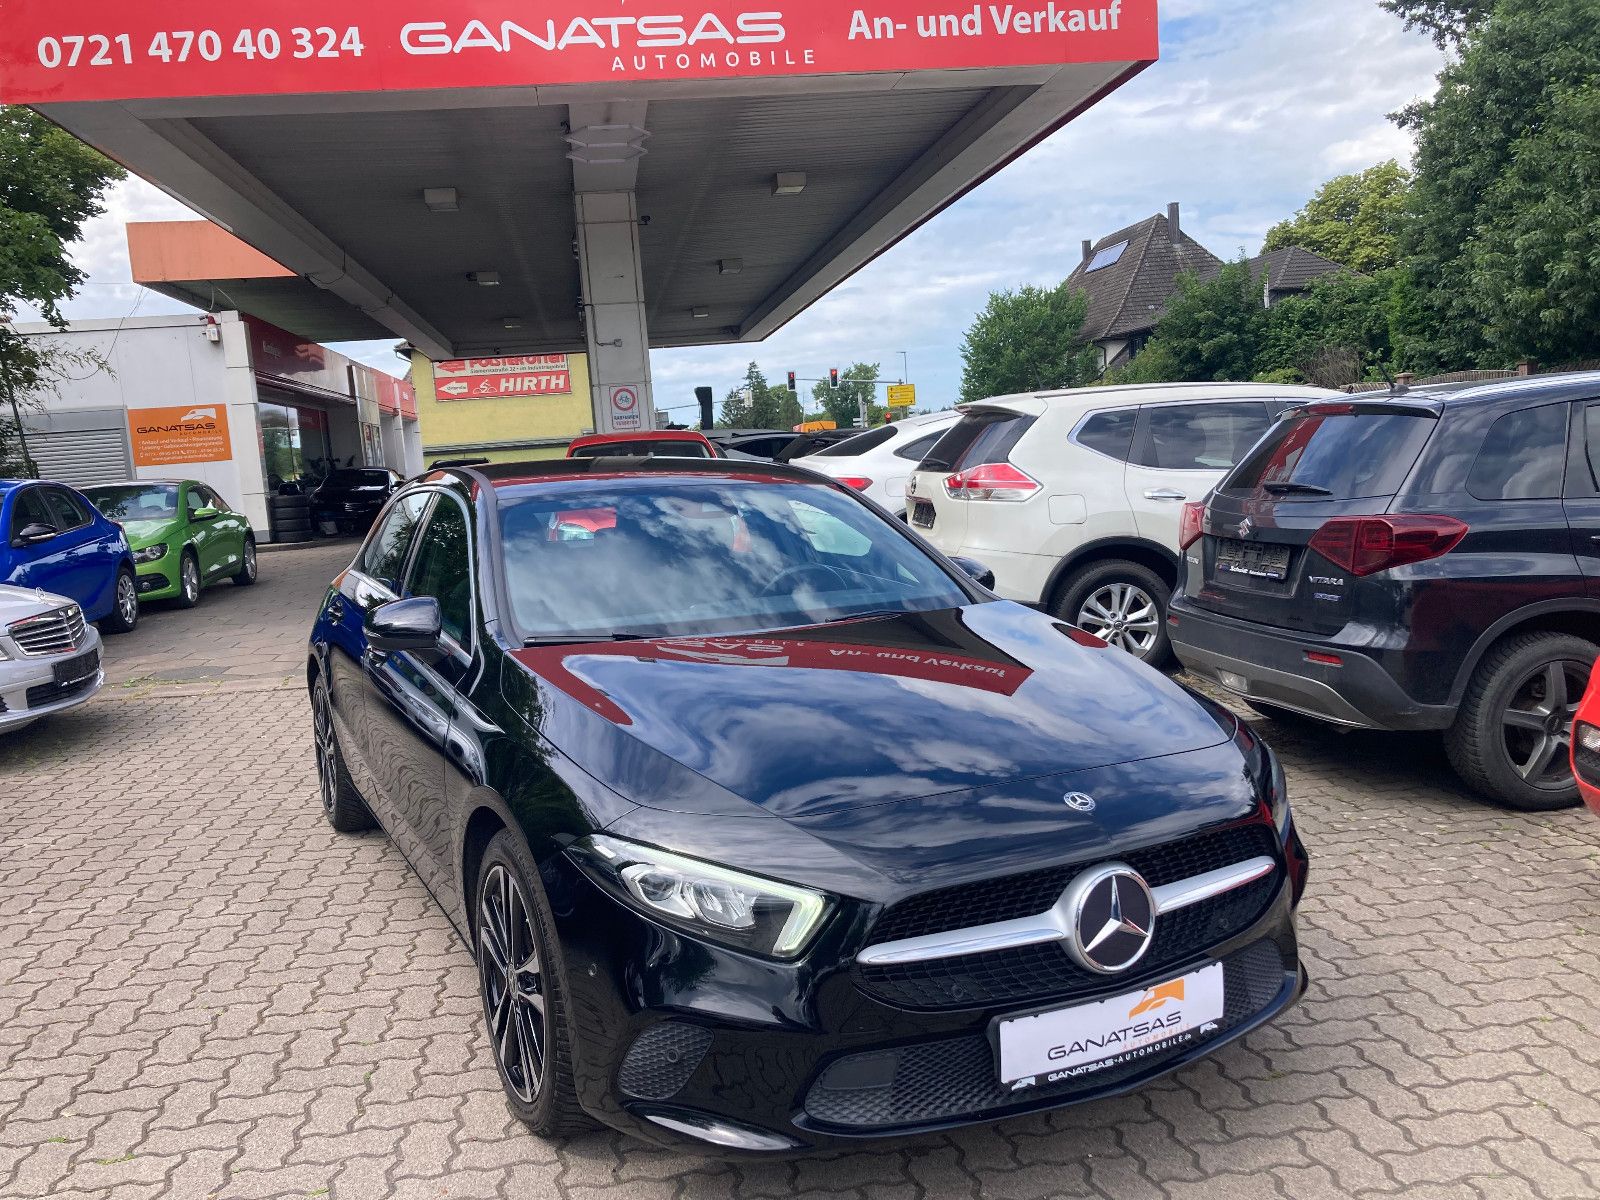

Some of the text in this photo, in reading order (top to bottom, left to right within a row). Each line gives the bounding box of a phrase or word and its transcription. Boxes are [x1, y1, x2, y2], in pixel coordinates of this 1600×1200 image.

[400, 10, 785, 56] GANATSAS
[847, 0, 1122, 41] An- und Verkauf
[37, 25, 364, 69] 0721 470 40 324
[612, 50, 816, 72] AUTOMOBILE
[499, 374, 566, 393] HIRTH
[137, 422, 216, 434] GANATSAS
[1047, 1011, 1182, 1061] GANATSAS
